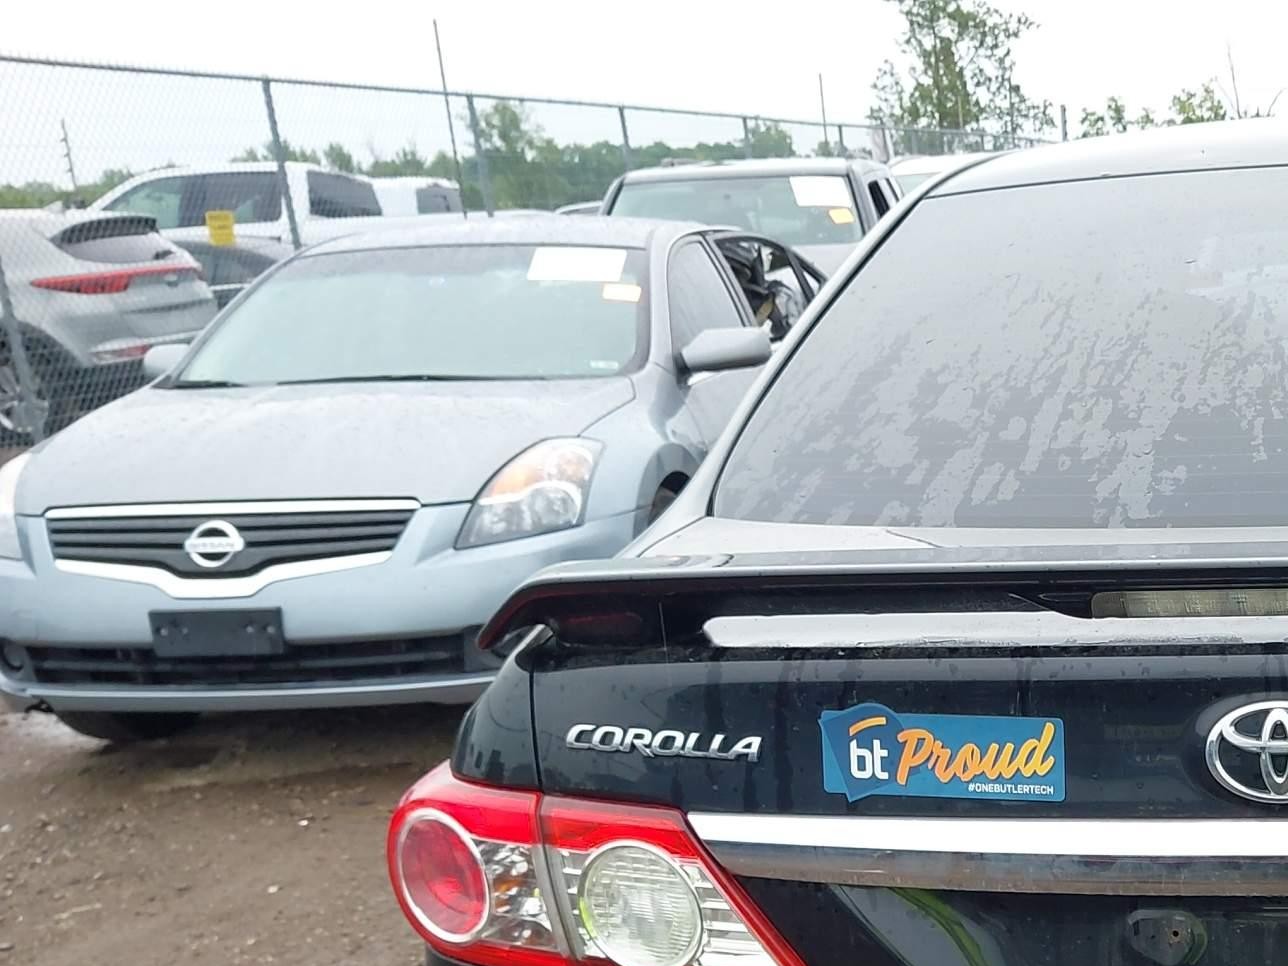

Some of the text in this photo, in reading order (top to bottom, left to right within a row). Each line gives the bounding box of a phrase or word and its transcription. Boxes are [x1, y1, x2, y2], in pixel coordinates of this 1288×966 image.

[566, 724, 762, 762] COROLLA
[850, 722, 1055, 785] bt Proud
[968, 782, 1055, 796] #ONEBUTLERTECH
